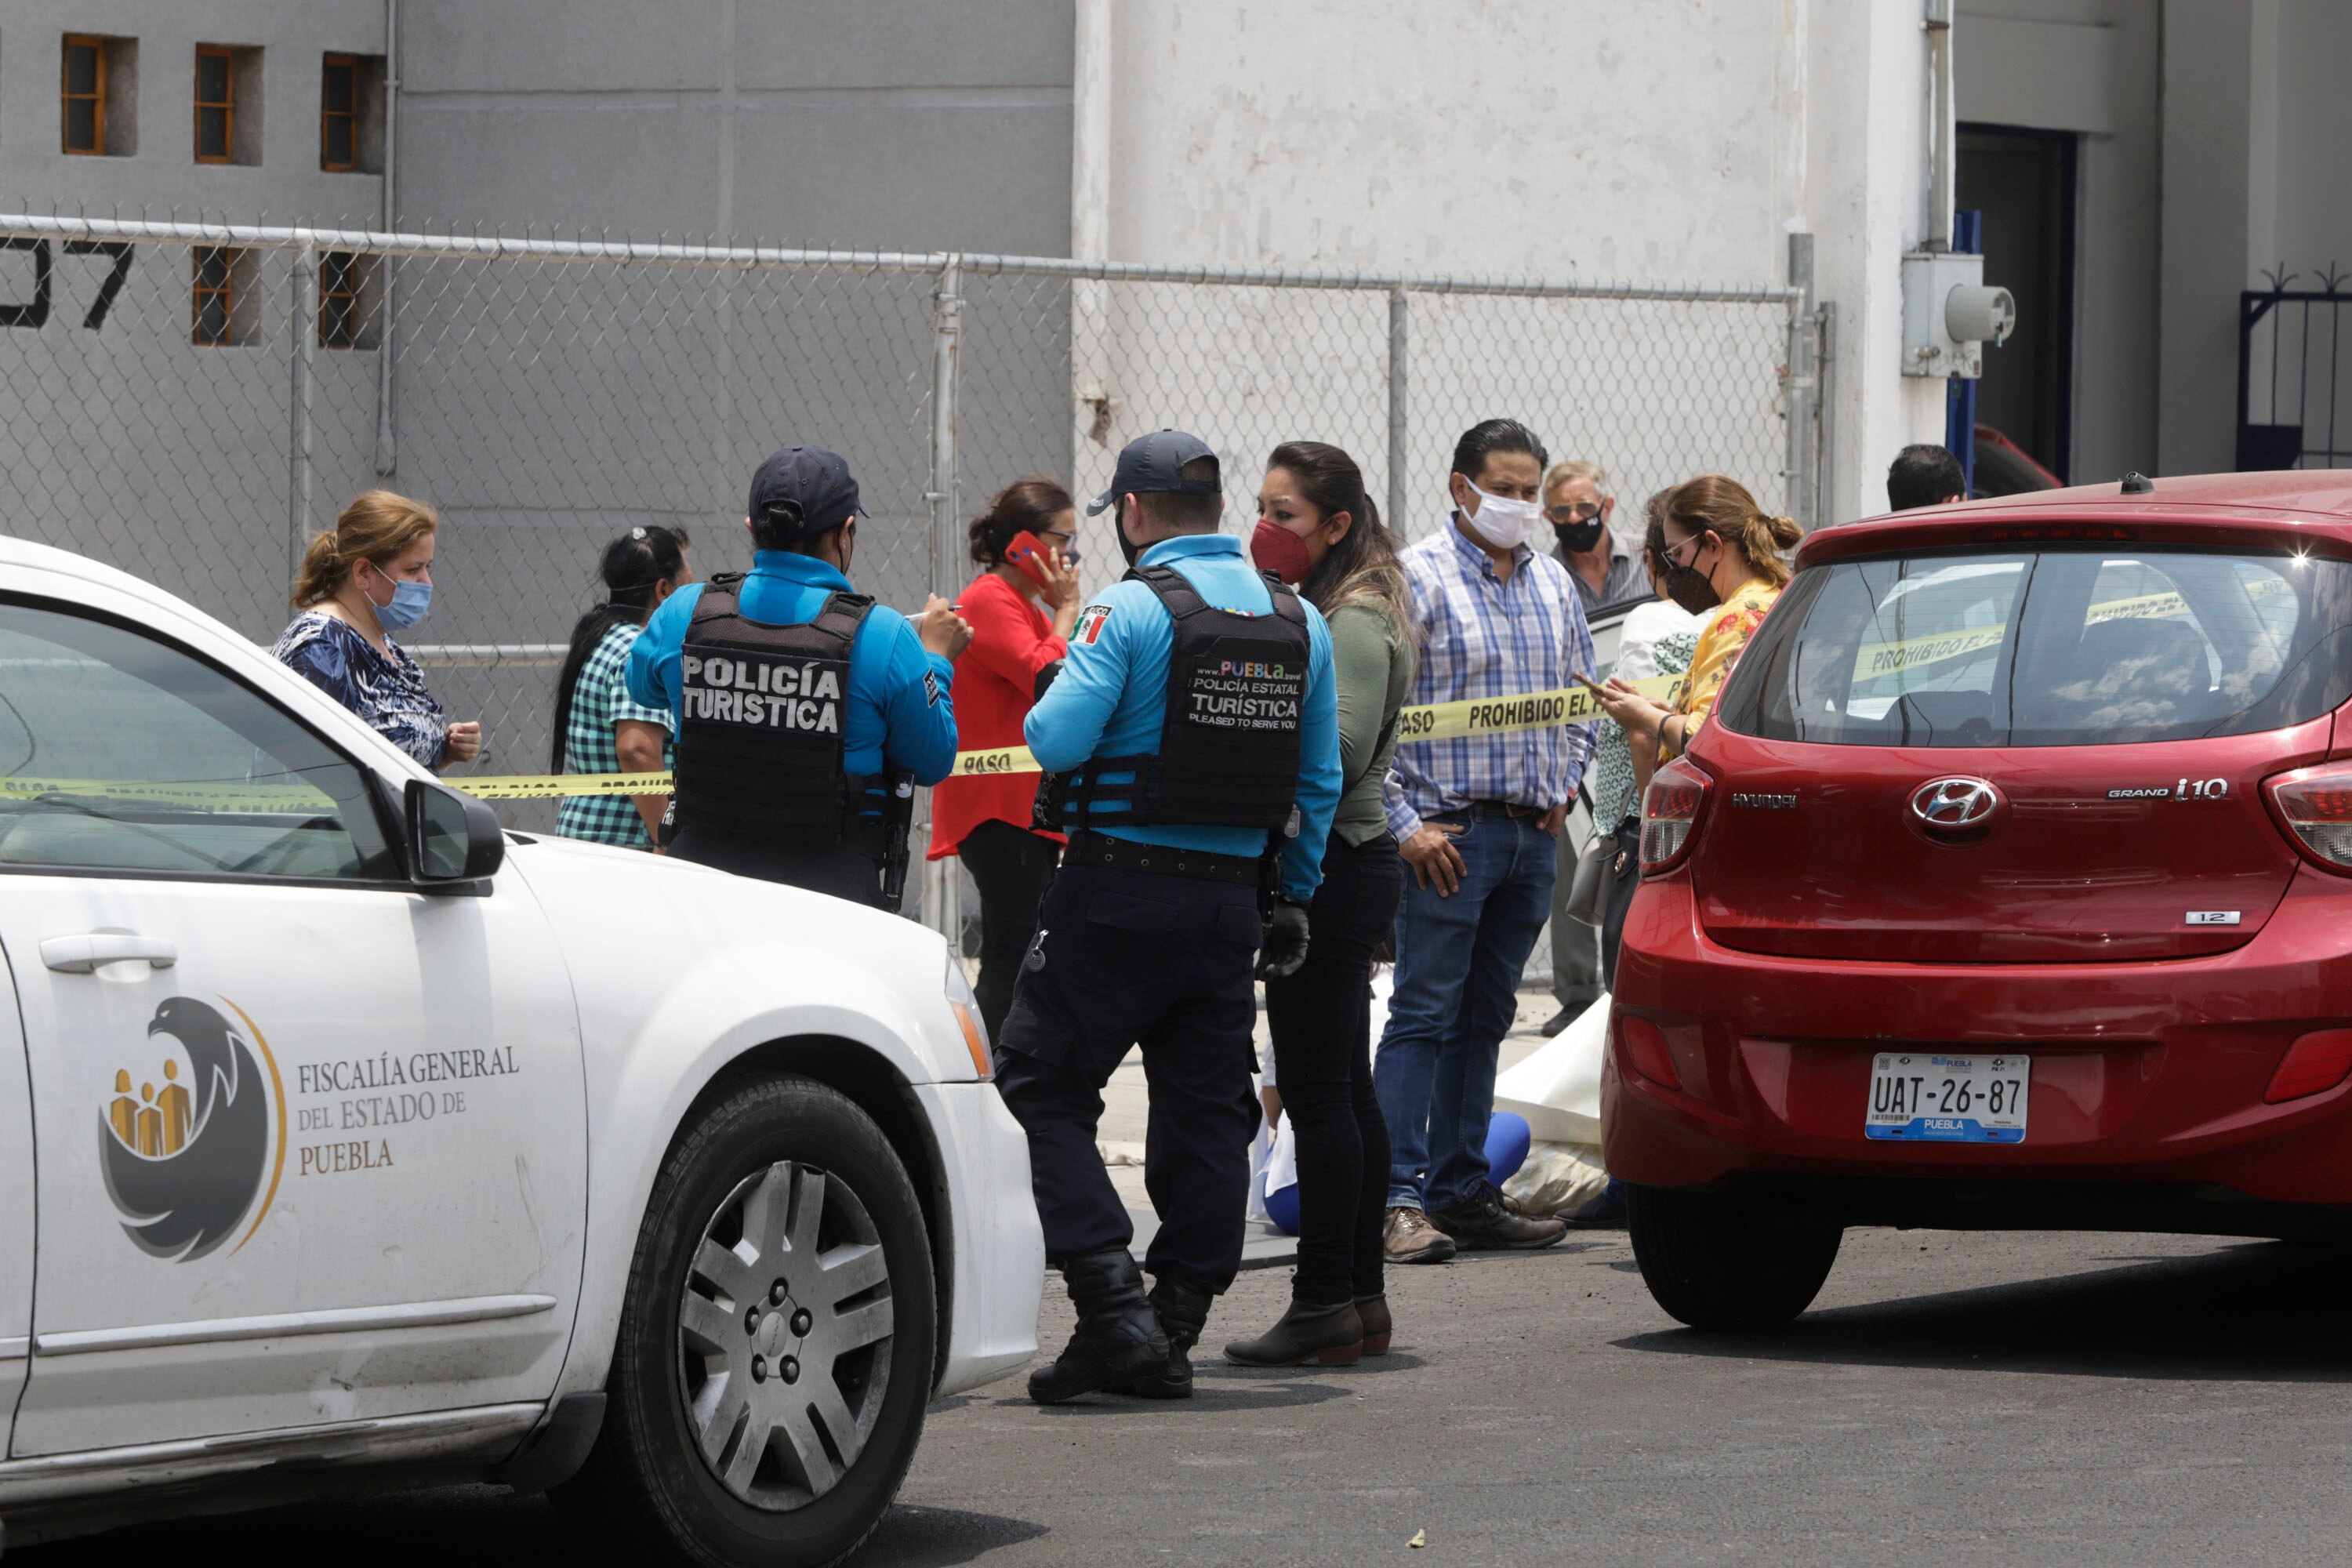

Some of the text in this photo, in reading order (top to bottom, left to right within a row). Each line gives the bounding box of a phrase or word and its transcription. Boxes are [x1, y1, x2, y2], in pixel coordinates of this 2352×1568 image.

[1872, 638, 1963, 672] PROHIBIDO
[1962, 634, 1984, 651] EL
[683, 655, 840, 699] POLICÍA
[1193, 678, 1299, 695] POLICÍA ESTATAL
[683, 686, 838, 734] TURISTICA
[1189, 713, 1296, 730] PLEASED TO SERVE YOU
[1192, 693, 1298, 718] TURÍSTICA
[1397, 710, 1435, 735] ASO
[1469, 696, 1564, 729] PROHIBIDO
[1569, 693, 1588, 717] EL
[2108, 789, 2169, 797] GRAND
[2201, 913, 2225, 922] 1.2
[298, 1045, 520, 1094] FISCALÍA GENERAL
[298, 1091, 466, 1132] DEL ESTADO DE
[1875, 1076, 2021, 1115] UAT-26-87
[1924, 1119, 1964, 1130] PUEBLA
[299, 1138, 394, 1176] PUEBLA
